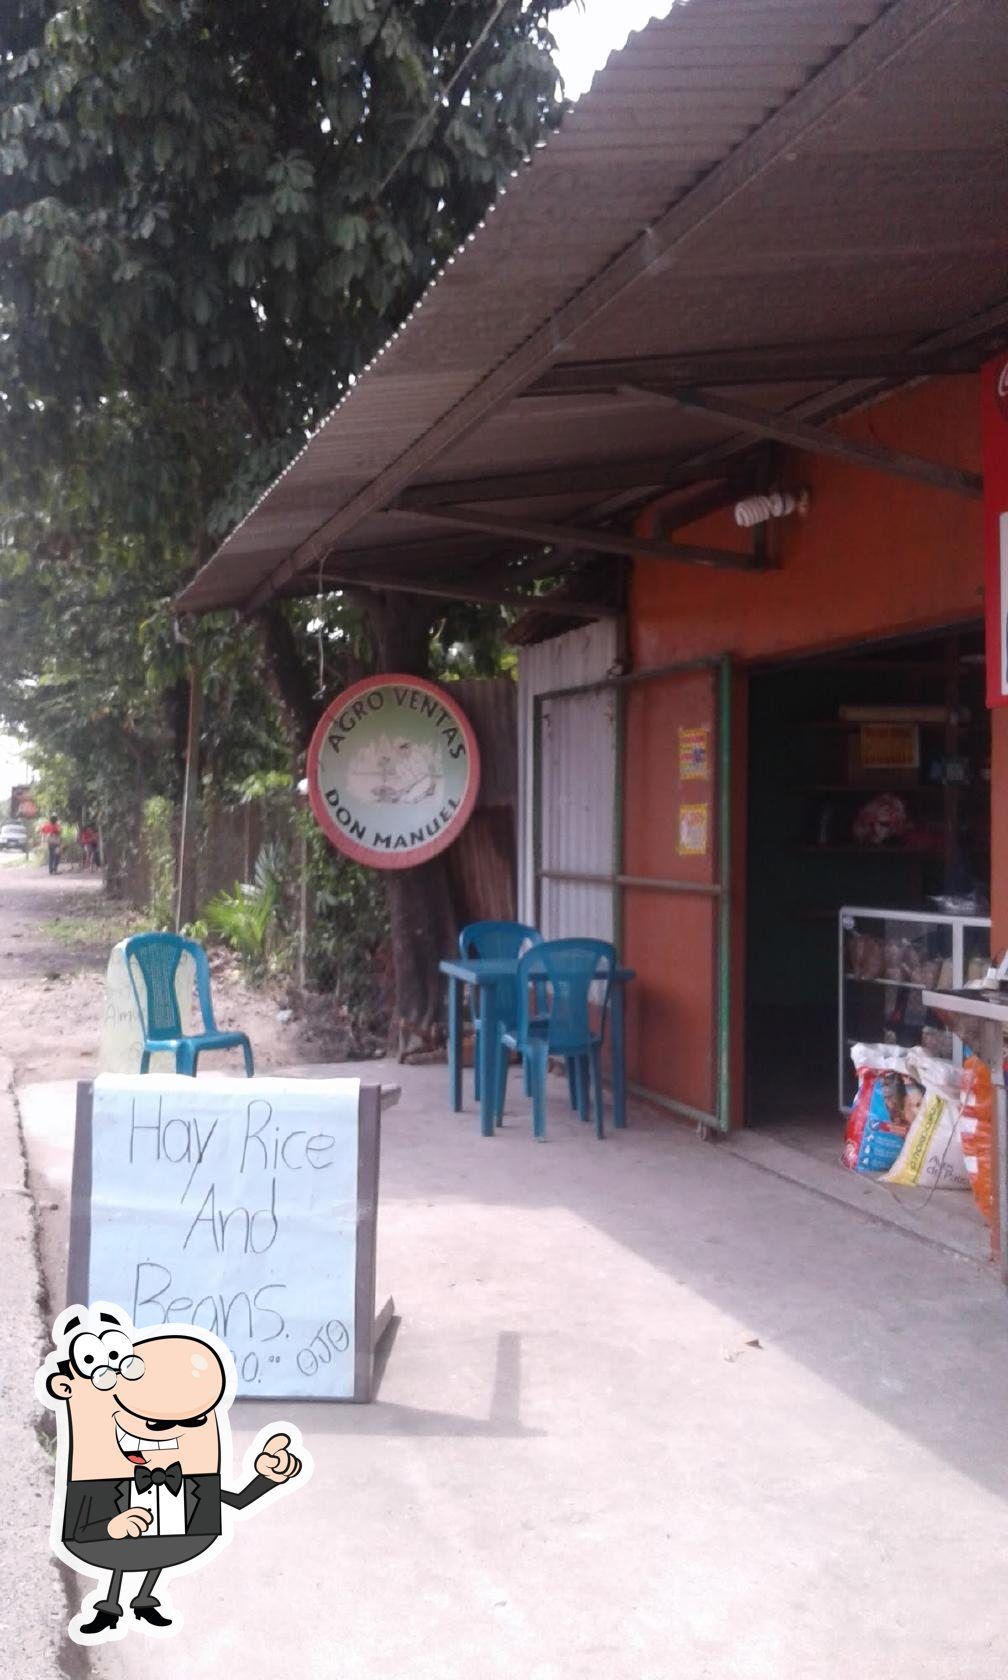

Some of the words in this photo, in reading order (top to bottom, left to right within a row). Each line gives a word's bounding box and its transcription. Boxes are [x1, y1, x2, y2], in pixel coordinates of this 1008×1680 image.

[328, 691, 384, 754] AGRO
[393, 687, 466, 760] VENTAS
[325, 789, 367, 840] DON
[373, 798, 461, 849] MANUEL
[129, 1094, 218, 1205] Hay
[240, 1099, 335, 1173] Rice
[183, 1176, 278, 1254] And
